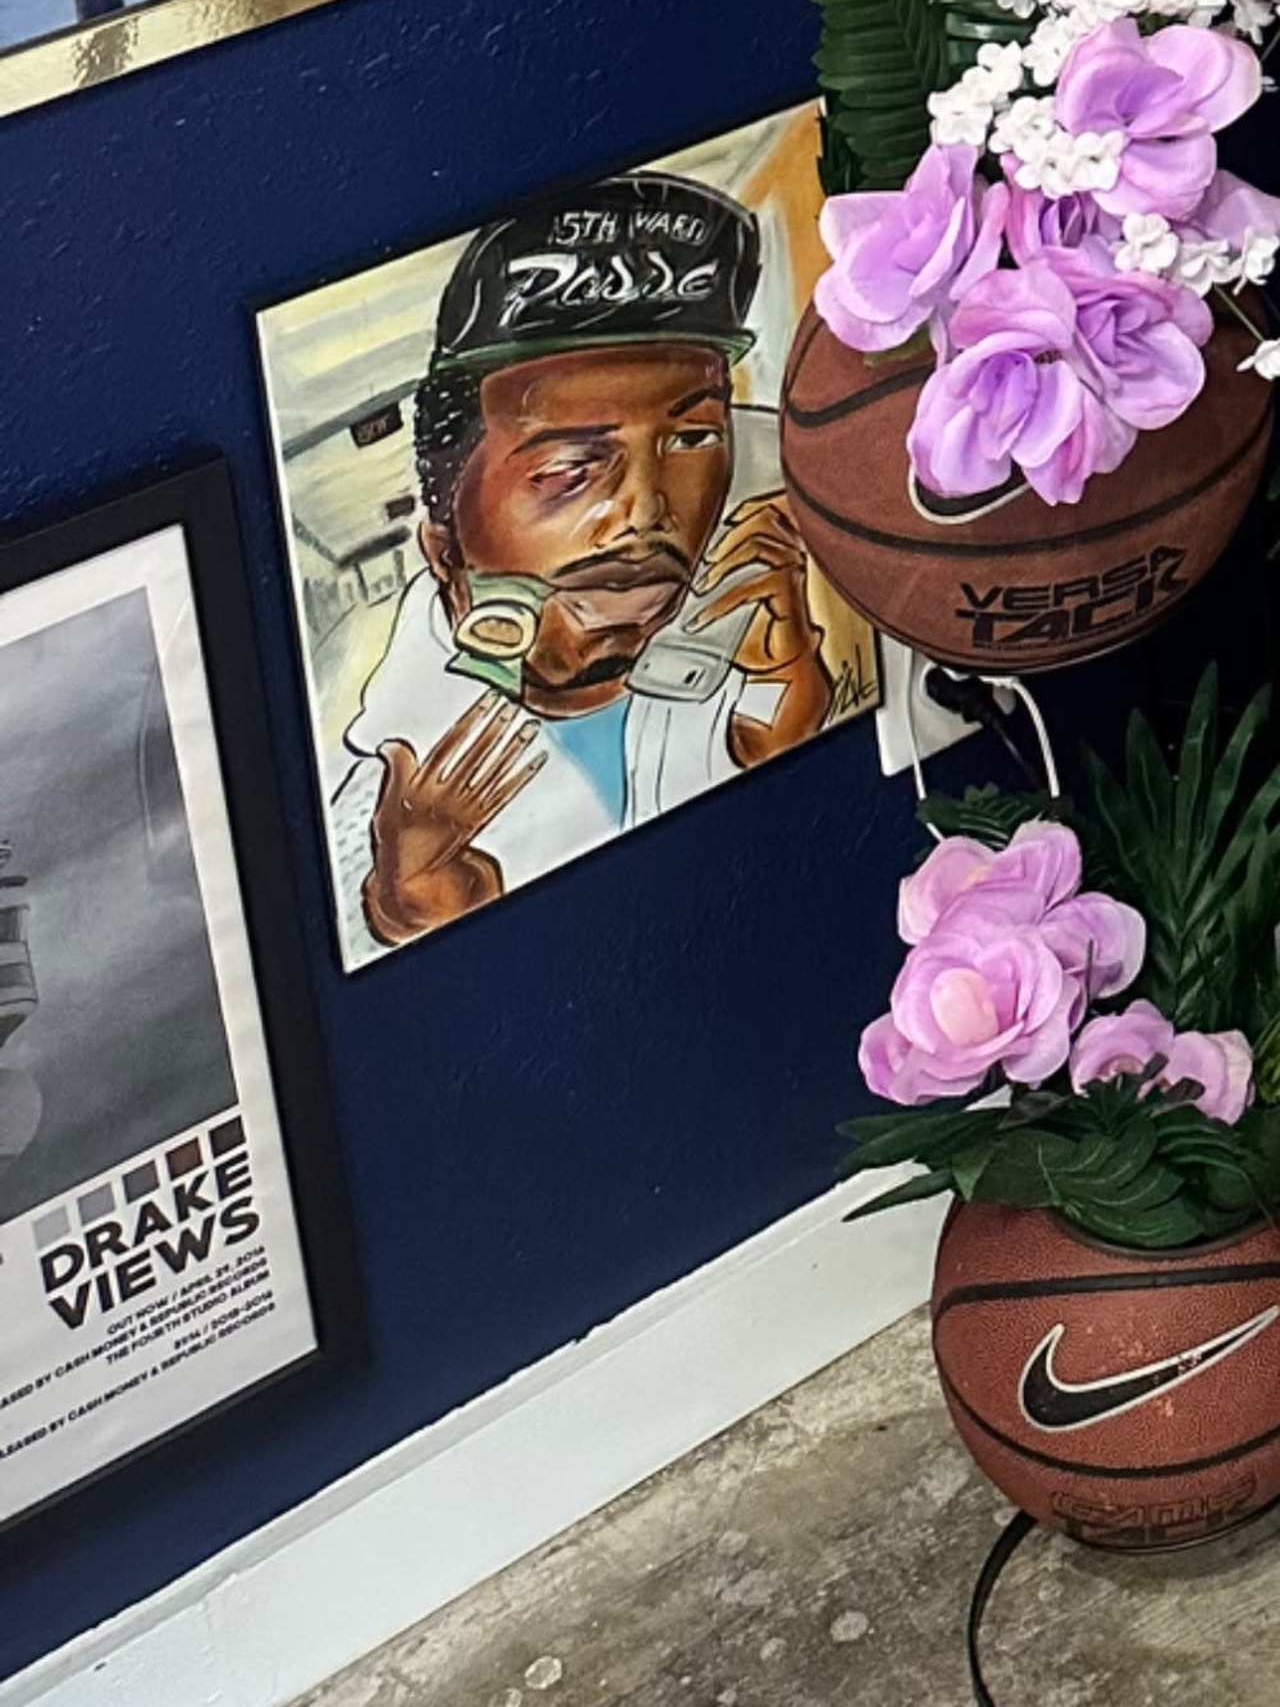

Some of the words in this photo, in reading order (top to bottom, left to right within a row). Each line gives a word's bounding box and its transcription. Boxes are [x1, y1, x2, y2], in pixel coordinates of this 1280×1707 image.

[555, 210, 618, 247] 5TH
[954, 571, 1191, 650] TACK
[961, 545, 1187, 611] VERSA
[40, 1151, 254, 1295] DRAKE
[49, 1196, 259, 1330] VIEWS
